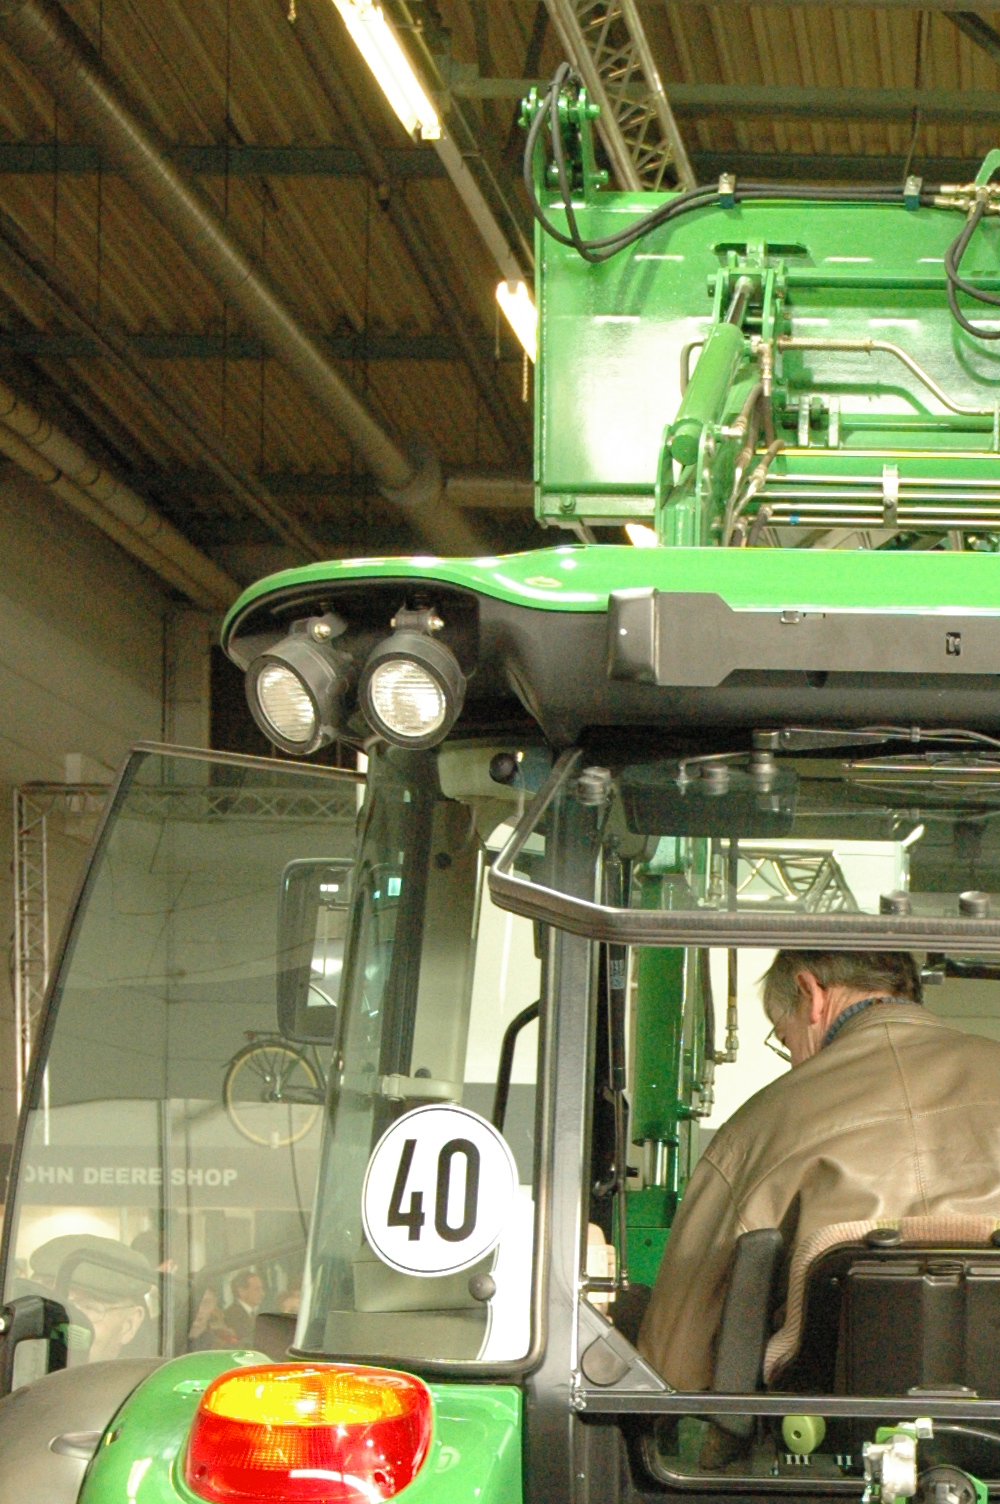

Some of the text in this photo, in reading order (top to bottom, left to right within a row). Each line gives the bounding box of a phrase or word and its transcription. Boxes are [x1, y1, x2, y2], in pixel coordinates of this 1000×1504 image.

[24, 1165, 238, 1187] OHN DEERE SHOP
[387, 1138, 480, 1242] 40
